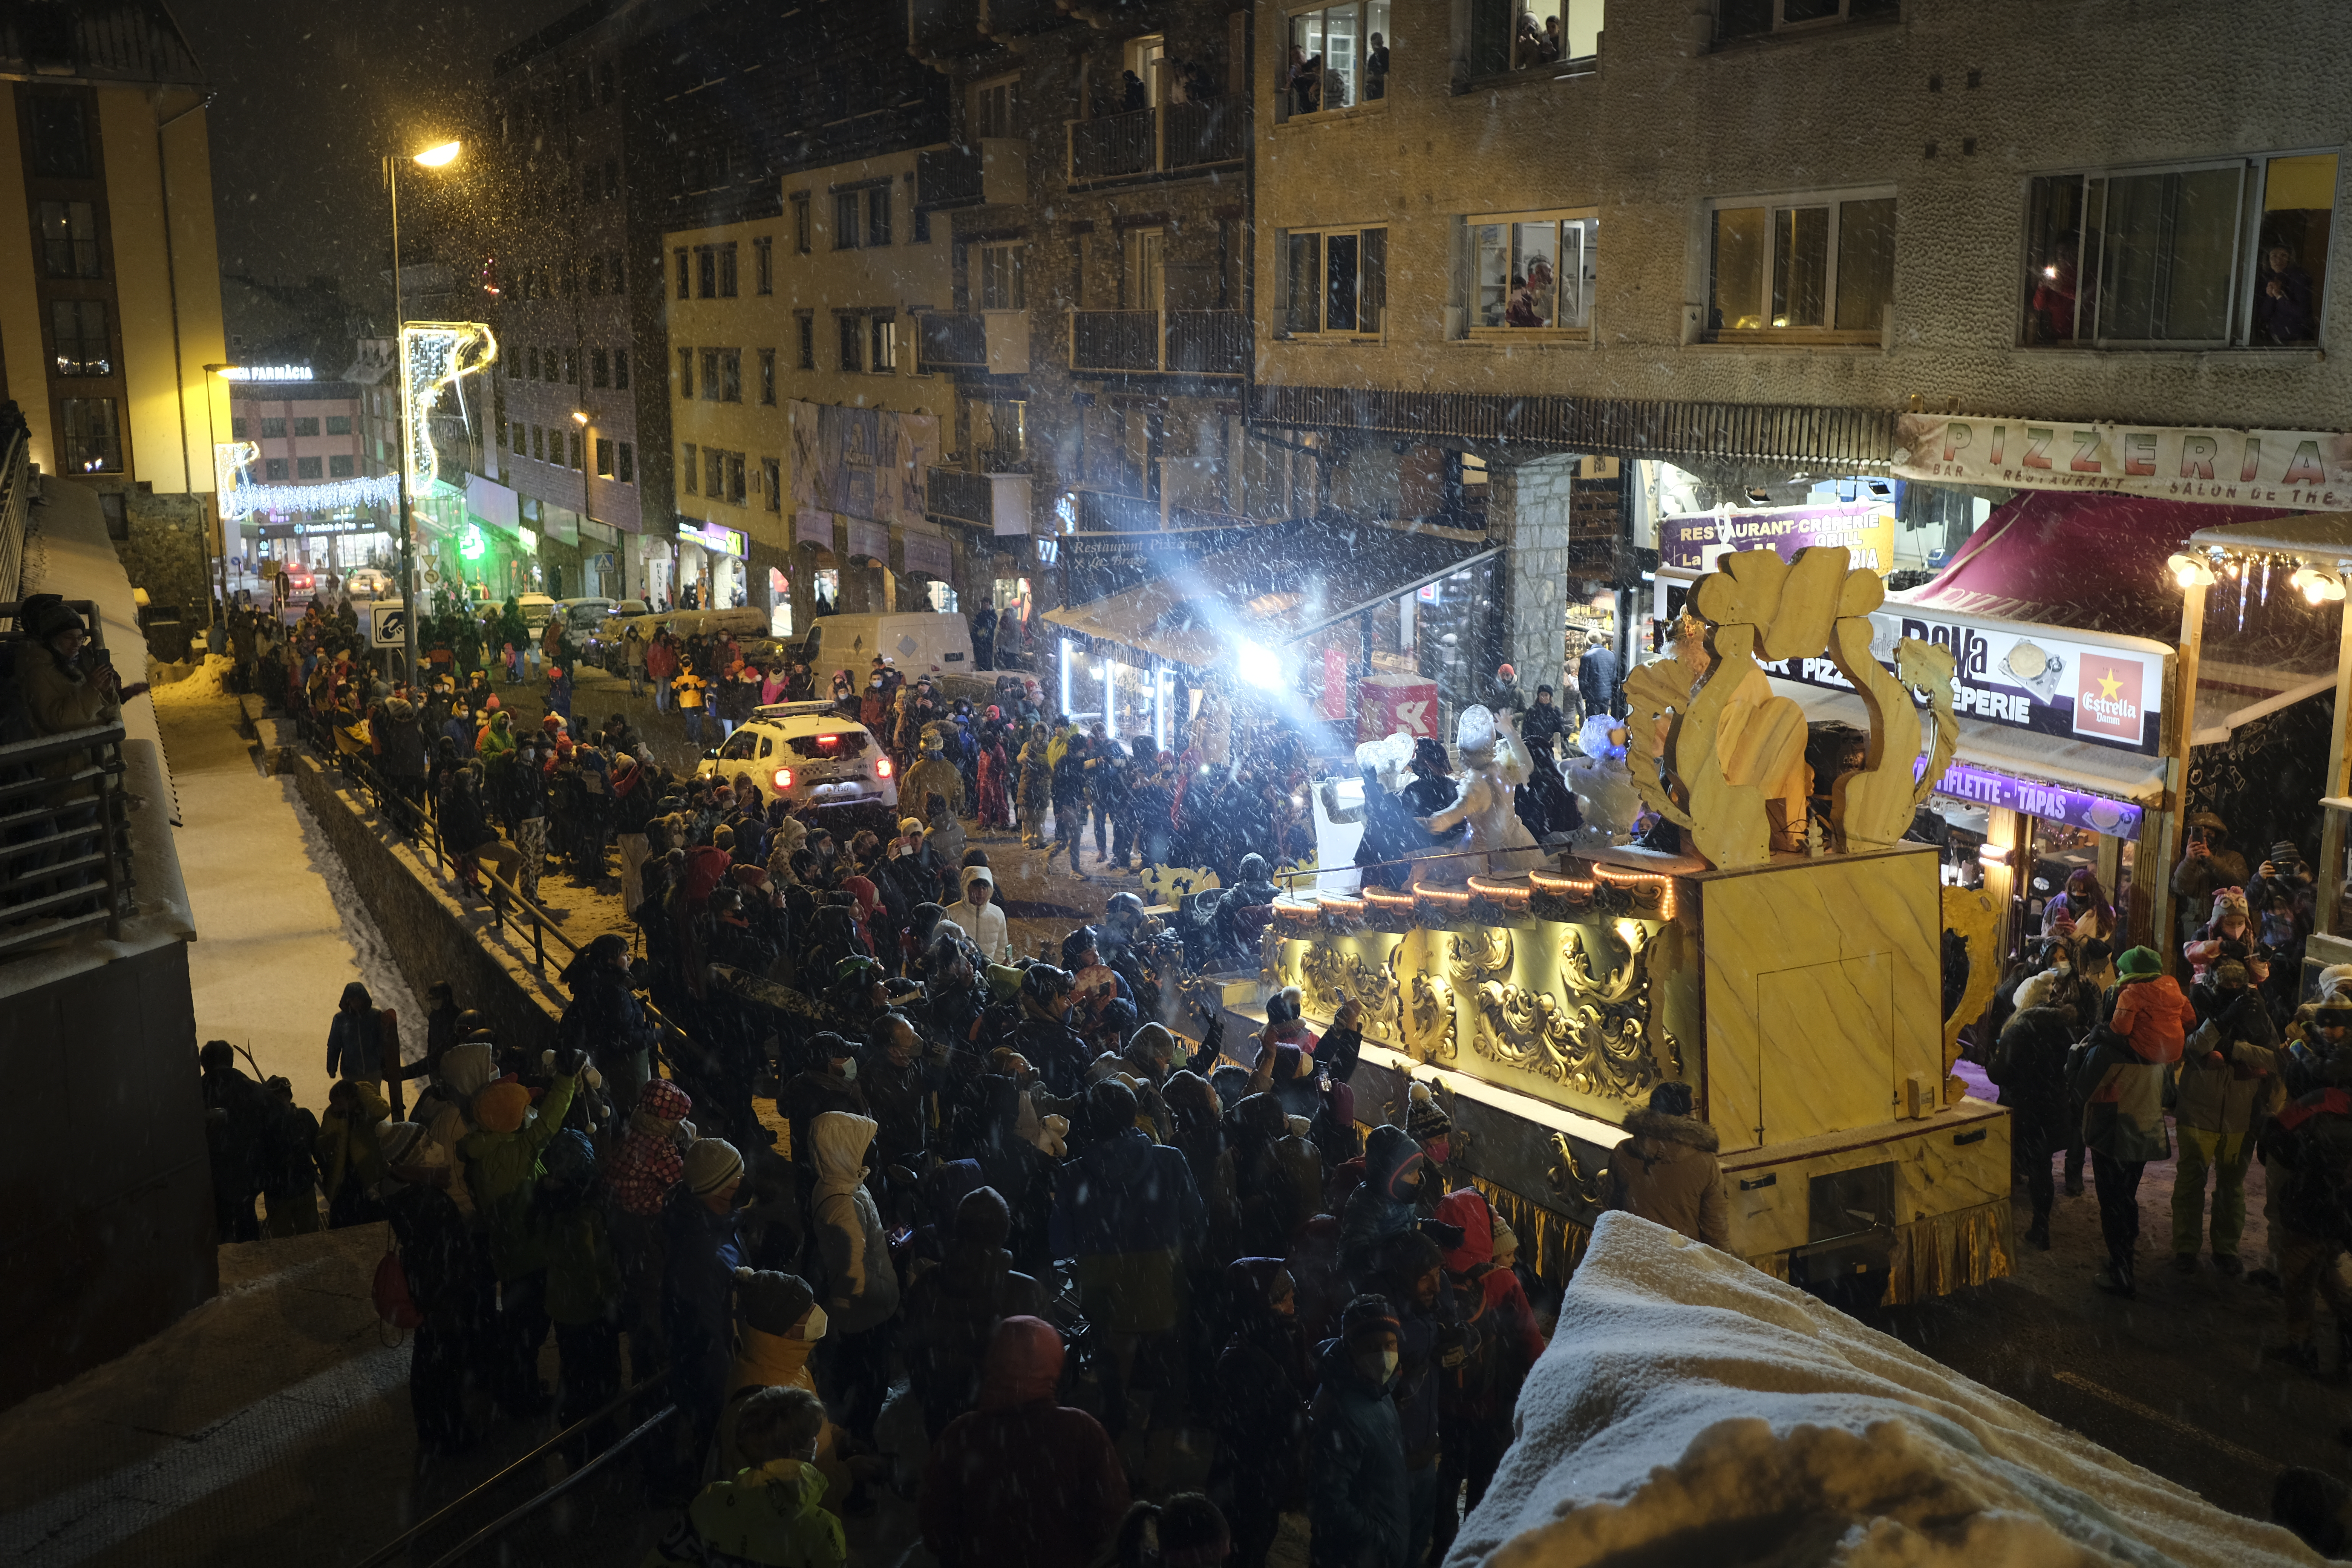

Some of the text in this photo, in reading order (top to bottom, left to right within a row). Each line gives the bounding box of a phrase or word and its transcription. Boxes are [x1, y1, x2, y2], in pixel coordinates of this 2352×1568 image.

[251, 364, 314, 380] FARMÀCIA
[1943, 422, 2326, 485] PIZZERIA
[1933, 464, 1963, 477] BAR
[2170, 482, 2237, 499] SALON
[2251, 490, 2275, 501] DE
[1799, 513, 1879, 533] CRÊPERIE
[1075, 538, 1199, 553] Restaurant Pizzeria
[1814, 531, 1863, 547] GRILL
[1090, 557, 1109, 568] La
[1683, 553, 1701, 566] La
[2082, 691, 2136, 719] Estrella
[2096, 712, 2120, 726] Damm
[2018, 785, 2066, 819] TAPAS
